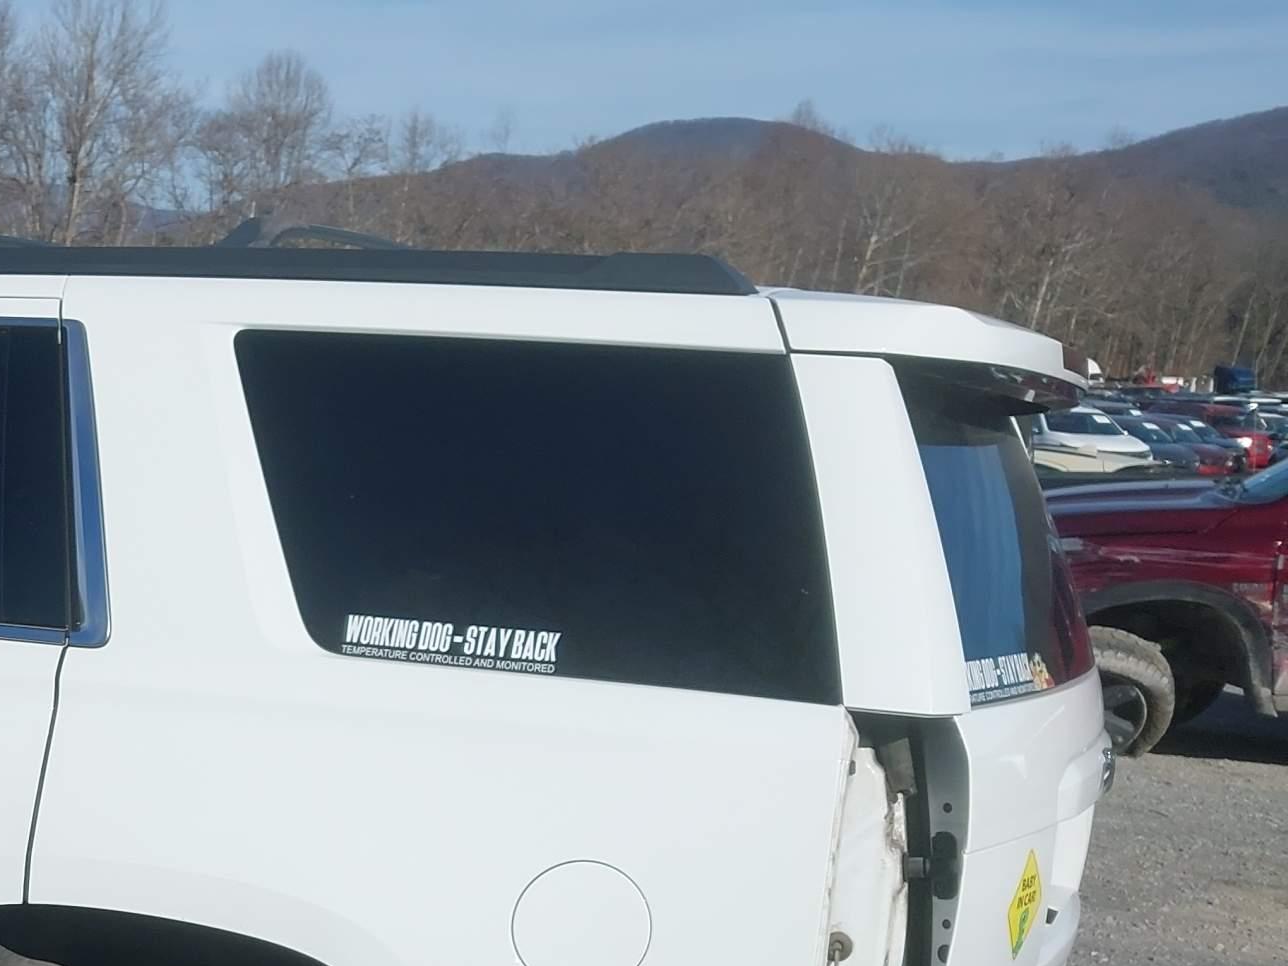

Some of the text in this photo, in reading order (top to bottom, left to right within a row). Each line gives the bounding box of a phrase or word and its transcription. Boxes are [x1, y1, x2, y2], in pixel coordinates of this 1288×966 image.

[345, 614, 419, 650] WORKING
[418, 621, 453, 653] DOG
[463, 625, 512, 659] STAY
[511, 630, 561, 662] BACK
[341, 644, 555, 674] TEMPERATURE CONTROLLED AND MONITORED
